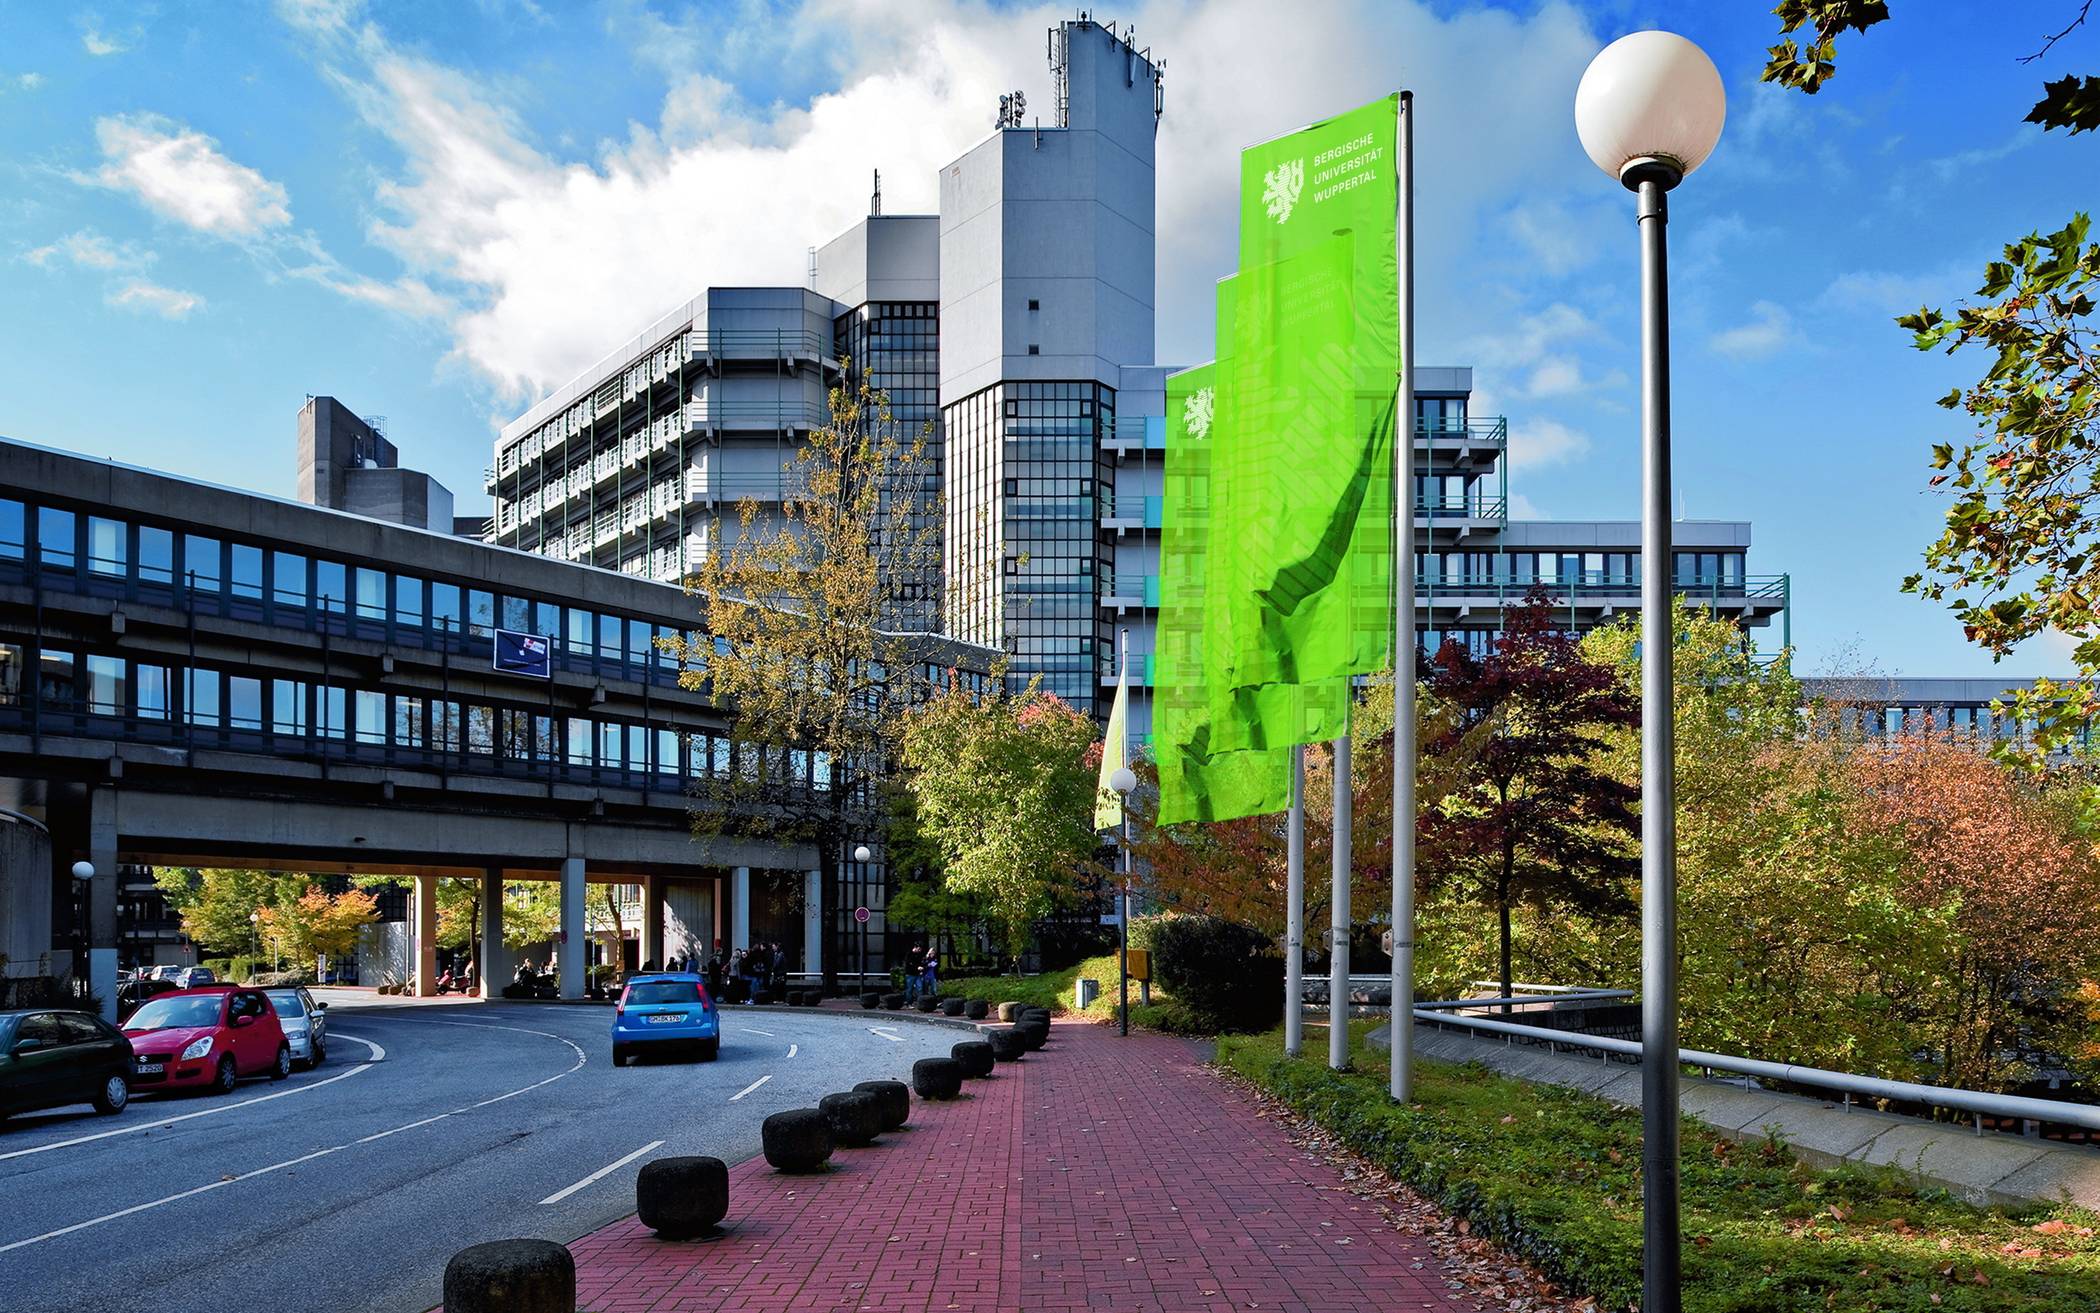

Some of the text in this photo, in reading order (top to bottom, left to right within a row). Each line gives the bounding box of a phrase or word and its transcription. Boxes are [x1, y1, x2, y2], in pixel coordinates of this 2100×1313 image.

[1313, 132, 1374, 167] BERGISCHE
[1314, 147, 1383, 185] UNIVERSITÄT
[1313, 169, 1377, 204] WUPPERTAL
